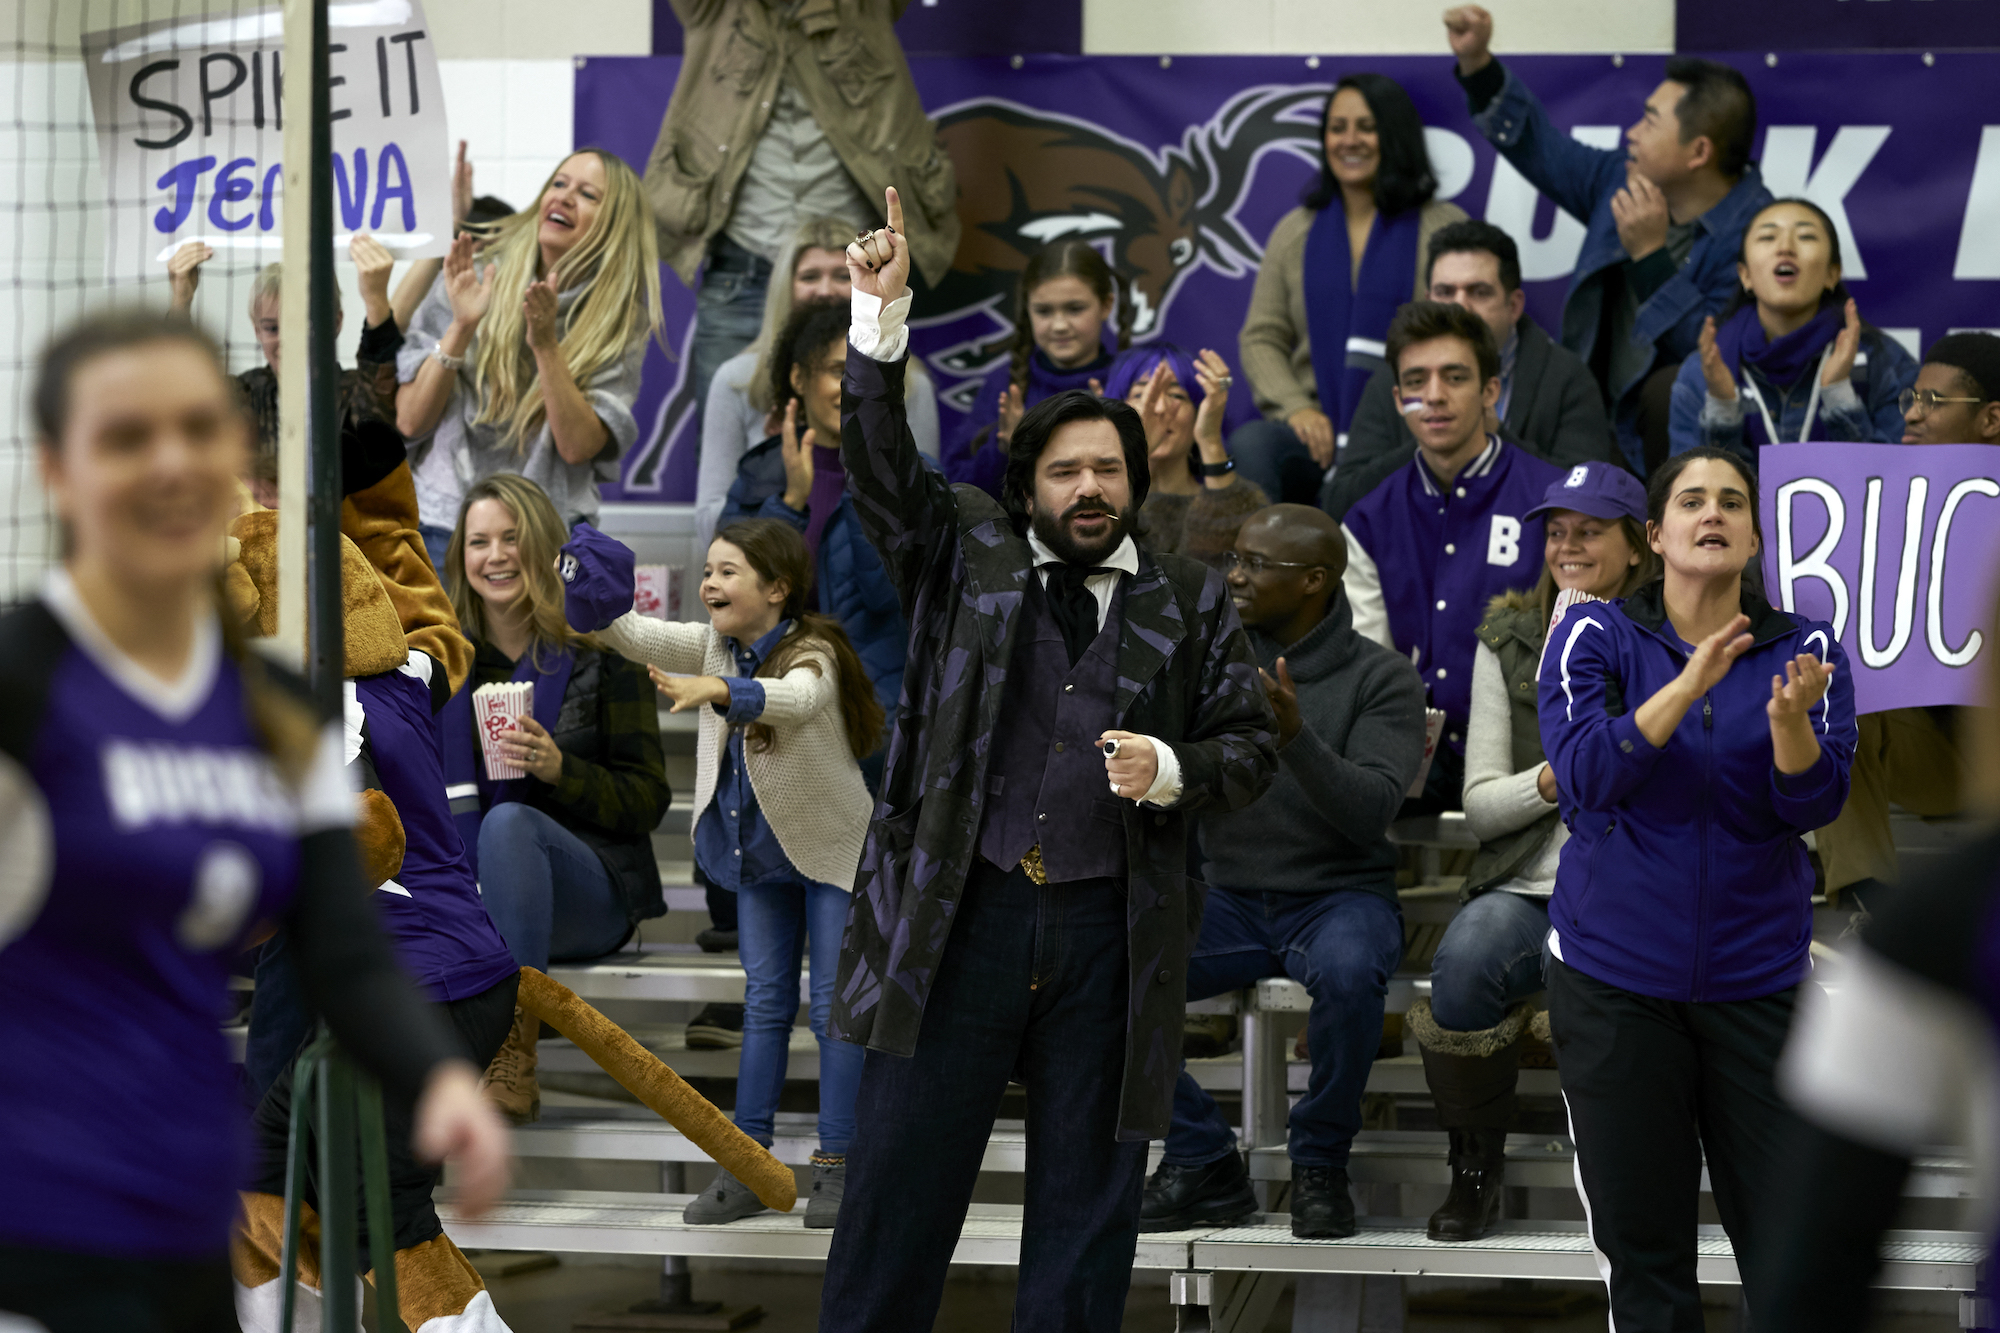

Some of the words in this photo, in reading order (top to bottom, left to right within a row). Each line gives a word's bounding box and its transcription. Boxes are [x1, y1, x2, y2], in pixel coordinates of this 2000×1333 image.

[129, 43, 352, 150] SPIE
[376, 30, 426, 118] IT
[1563, 465, 1589, 488] B
[1487, 513, 1521, 568] B
[560, 553, 579, 583] B
[1775, 475, 2000, 670] BUC
[485, 715, 507, 733] POP
